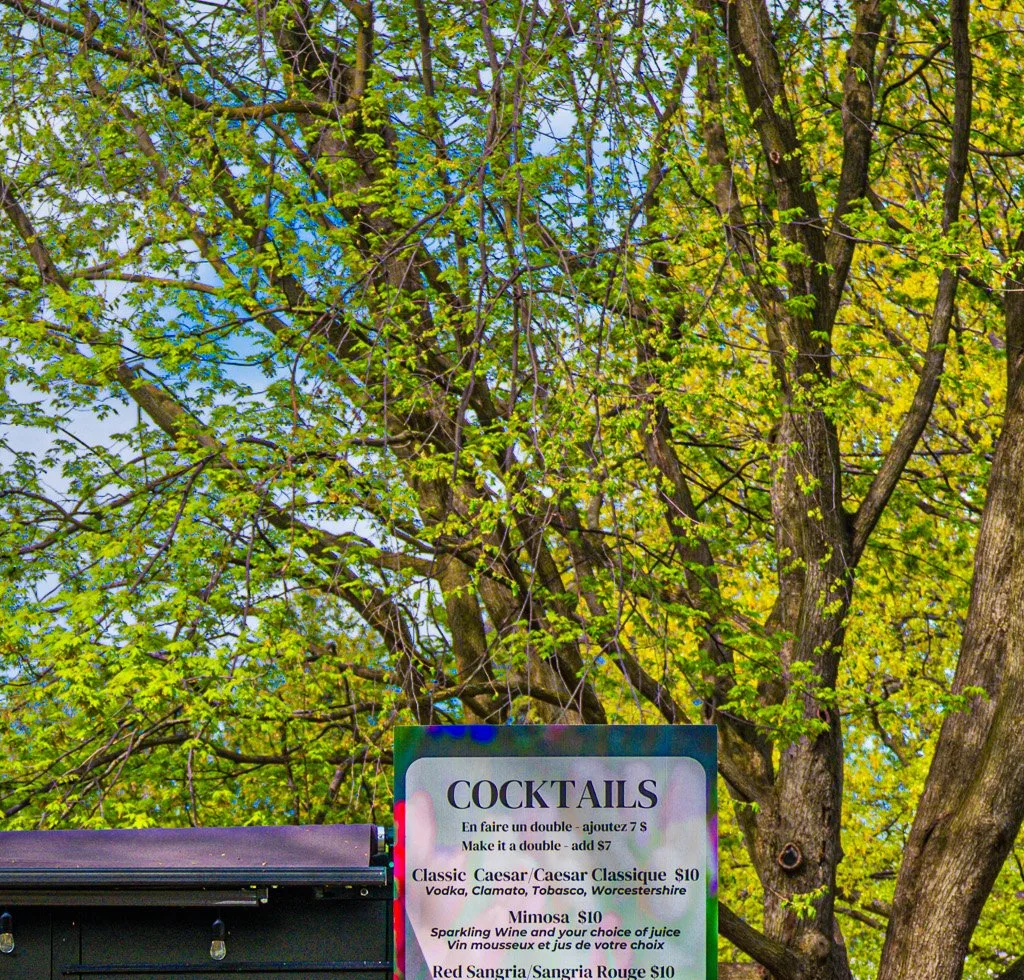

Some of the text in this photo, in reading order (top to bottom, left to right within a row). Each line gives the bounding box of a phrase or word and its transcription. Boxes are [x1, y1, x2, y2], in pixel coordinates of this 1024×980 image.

[448, 780, 657, 809] COCKTAILS
[462, 821, 646, 834] En faire un double ajoutez 7 $
[462, 841, 494, 851] Make
[498, 840, 505, 851] it
[519, 840, 561, 851] double
[572, 840, 594, 850] add
[598, 840, 611, 851] $7
[412, 868, 466, 881] Classic
[592, 868, 666, 885] Classique
[676, 868, 699, 881] $10
[426, 886, 686, 896] Vodka, Clamato, Tobasco, Worcestershire
[510, 911, 602, 923] Mimosa $10
[431, 927, 681, 939] Sparkling Wine and your choice of juice
[434, 965, 462, 978] Red
[651, 966, 674, 978] $10
